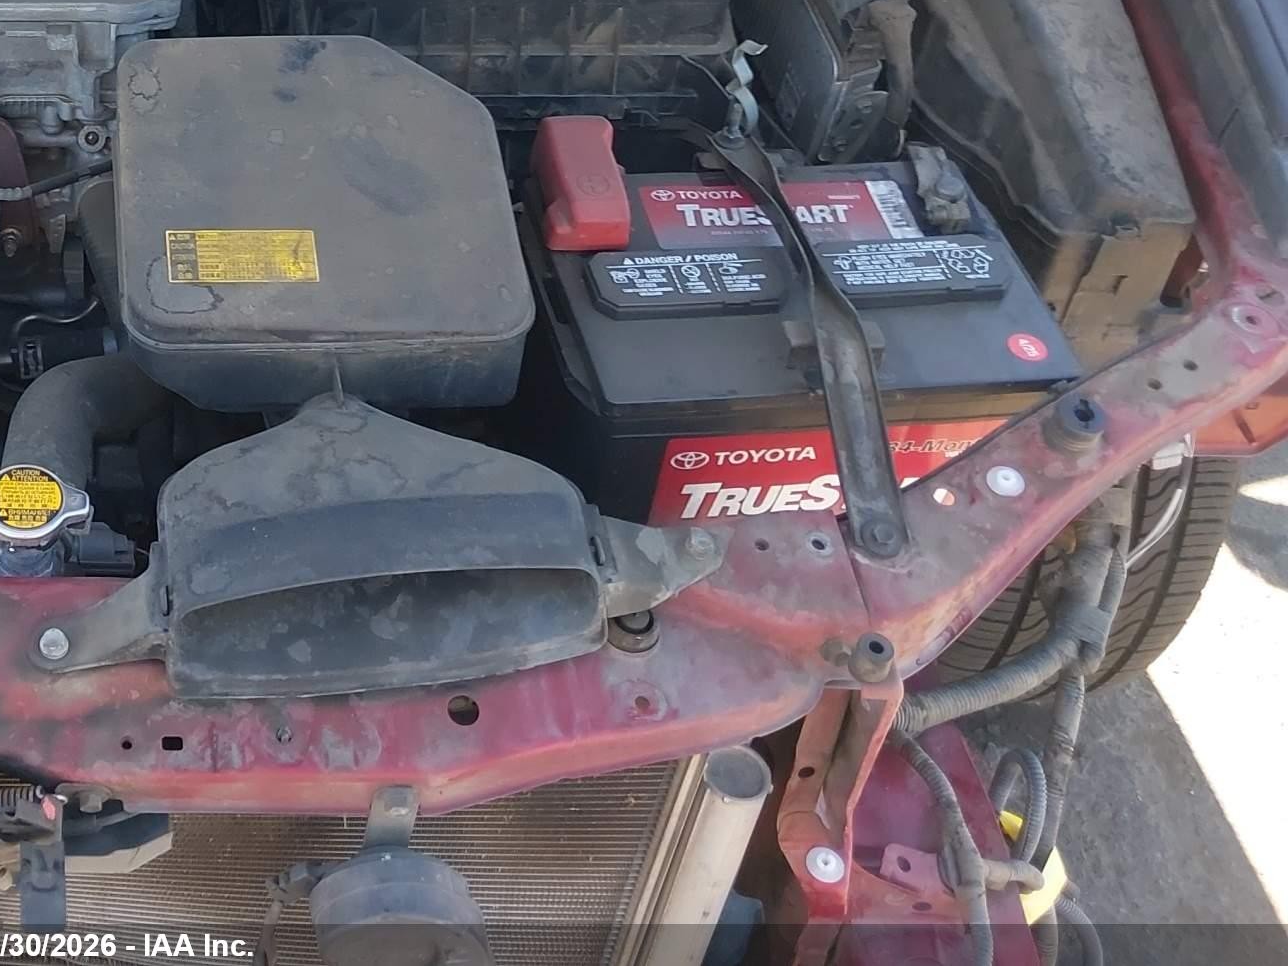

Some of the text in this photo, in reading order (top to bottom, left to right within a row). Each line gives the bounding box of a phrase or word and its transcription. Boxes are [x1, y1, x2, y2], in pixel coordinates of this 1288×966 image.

[677, 190, 742, 200] TOYOTA
[635, 255, 684, 265] DANGER
[695, 252, 738, 262] POISON
[714, 446, 817, 466] TOYOTA
